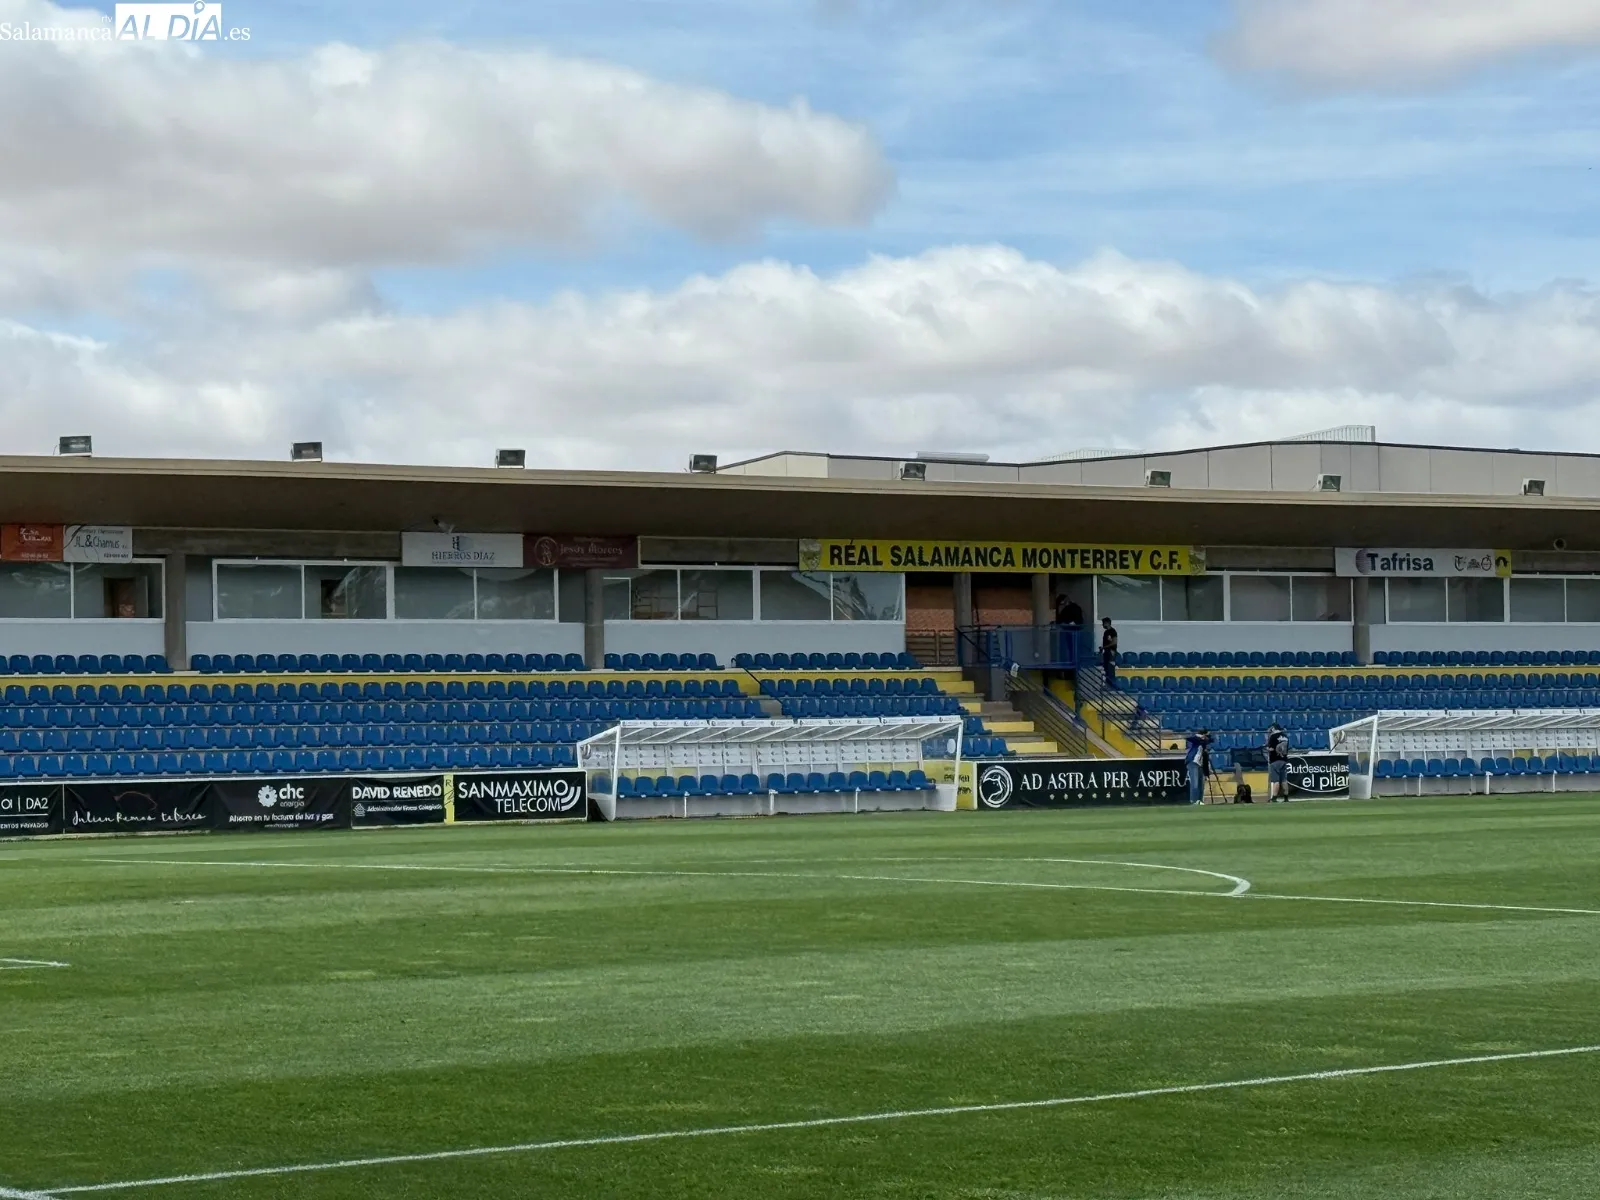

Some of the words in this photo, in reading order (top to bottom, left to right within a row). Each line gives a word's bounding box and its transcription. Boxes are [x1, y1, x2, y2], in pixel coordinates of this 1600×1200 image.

[432, 551, 471, 561] HIERROS
[890, 545, 1016, 568] SALAMANCA
[1022, 547, 1144, 570] MONTERREY
[1149, 549, 1182, 571] C.F.
[1366, 552, 1434, 572] Tafrisa
[1020, 773, 1043, 791] AD
[1047, 771, 1098, 790] ASTRA
[1103, 770, 1131, 789] PER
[1136, 769, 1191, 788] ASPERA
[1302, 773, 1315, 788] el
[1319, 772, 1349, 790] pilar
[279, 783, 305, 800] chc
[352, 786, 390, 800] DAVID
[392, 784, 442, 799] RENEDO
[458, 779, 569, 799] SANMAXIMO
[26, 797, 49, 810] DA2
[494, 797, 561, 814] TELECOM
